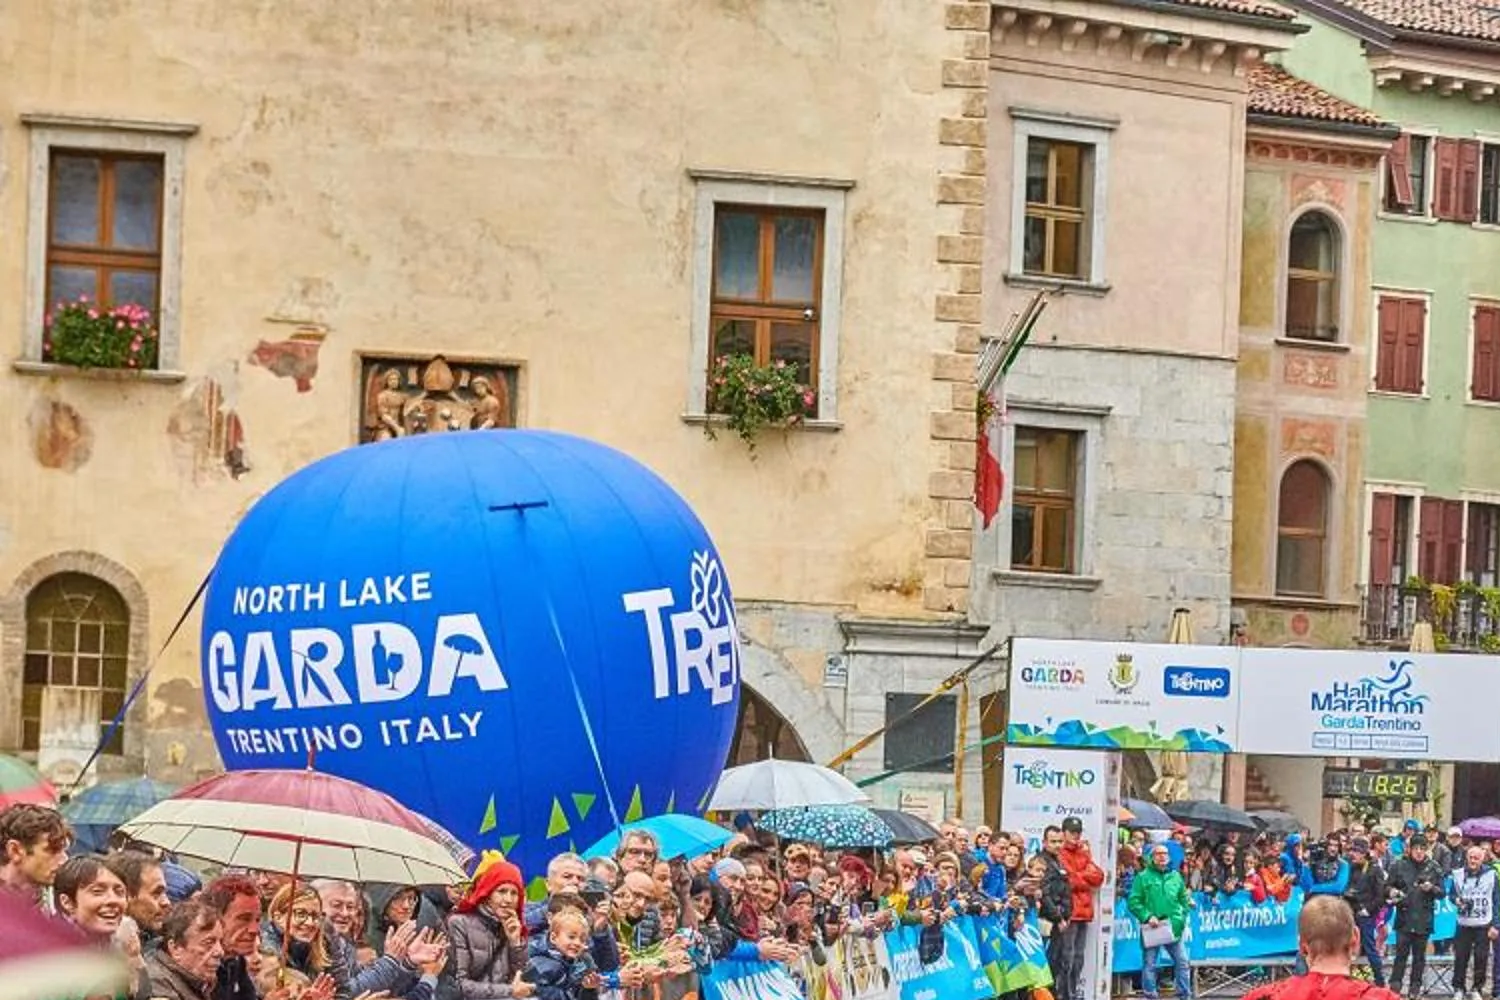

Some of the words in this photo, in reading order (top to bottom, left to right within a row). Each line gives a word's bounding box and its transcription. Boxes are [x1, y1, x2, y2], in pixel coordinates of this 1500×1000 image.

[233, 580, 325, 615] NORTH
[339, 571, 433, 607] LAKE
[208, 613, 508, 713] GARDA
[1020, 667, 1086, 684] GARDA
[227, 724, 363, 755] TRENTINO
[380, 710, 484, 747] ITALY
[1013, 762, 1095, 789] TRENTINO
